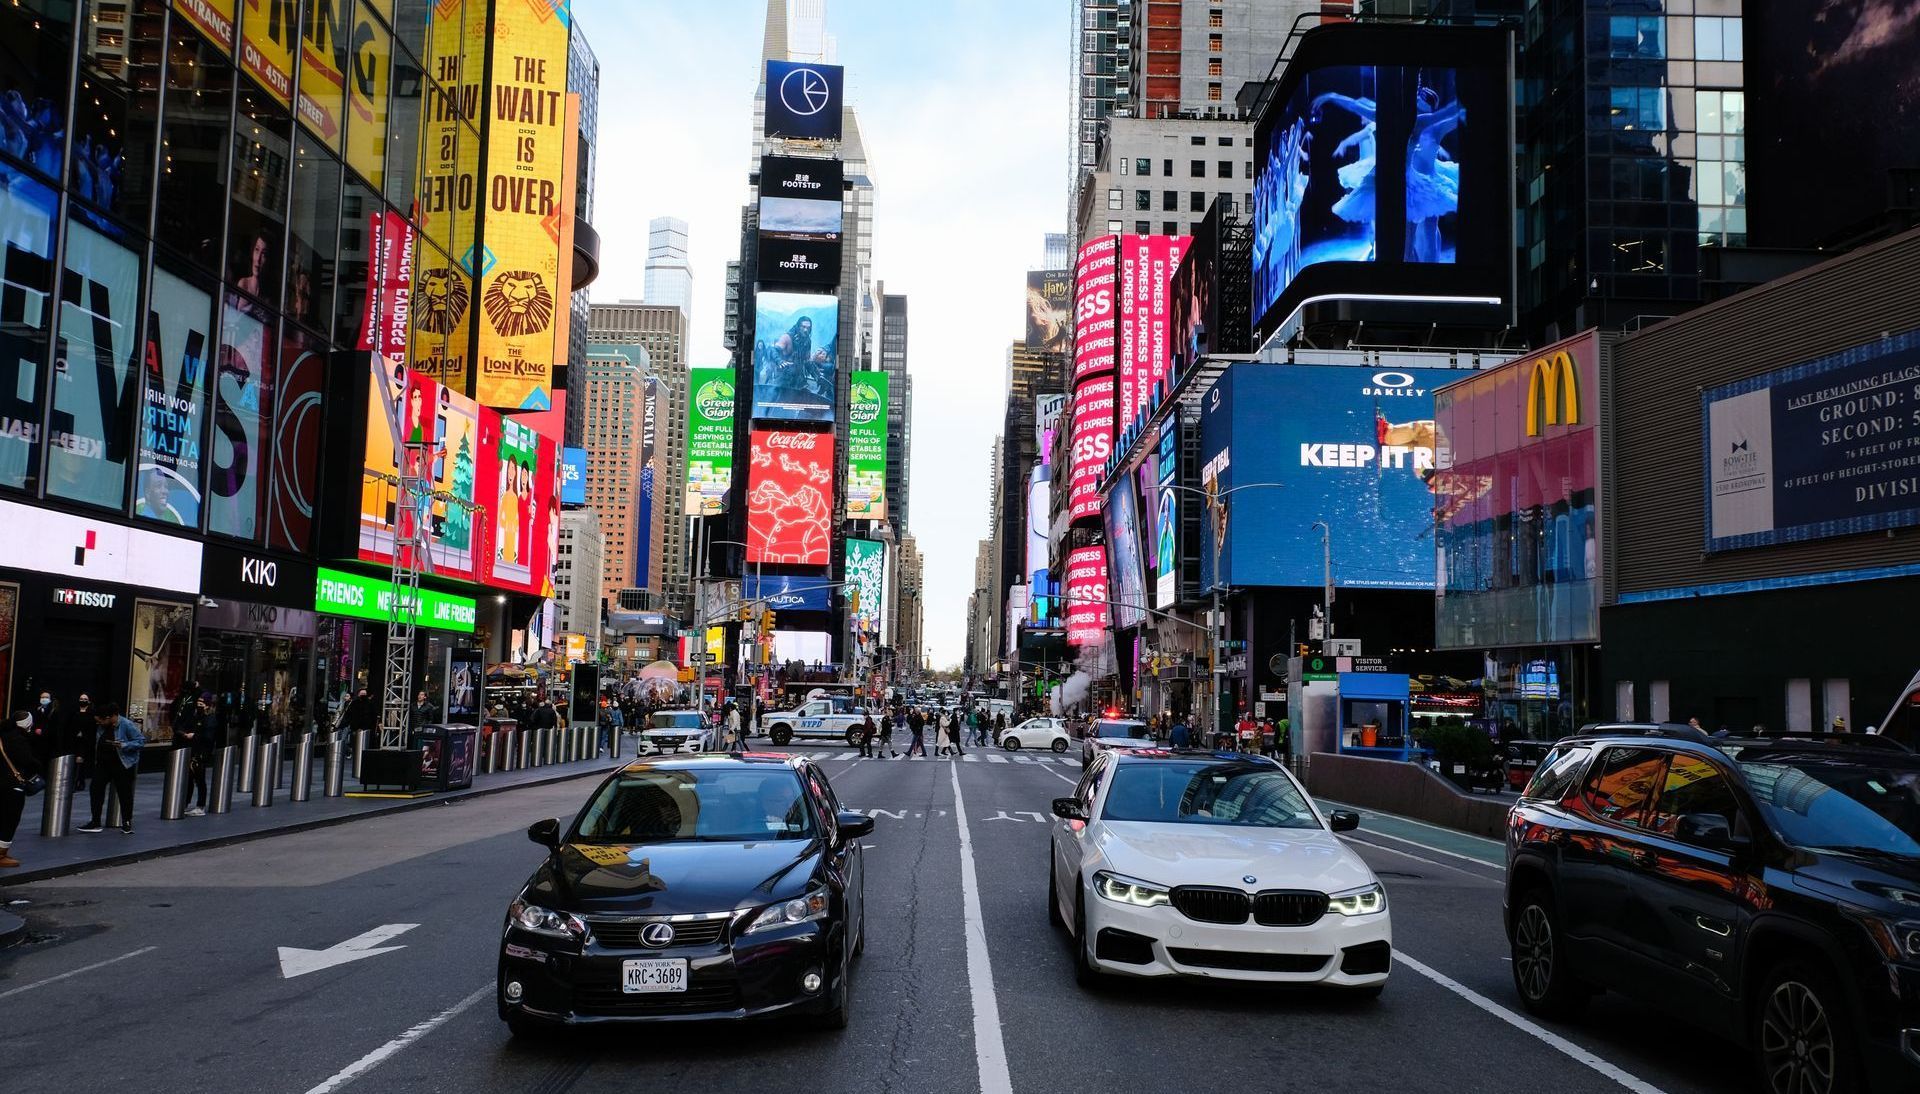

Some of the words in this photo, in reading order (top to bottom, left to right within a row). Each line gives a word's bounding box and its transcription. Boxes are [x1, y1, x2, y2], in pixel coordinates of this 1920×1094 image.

[514, 56, 546, 85] THE
[245, 46, 261, 69] ON
[266, 66, 288, 95] 45TH
[299, 94, 324, 127] STREET
[496, 84, 560, 126] WAIT
[516, 136, 536, 163] IS
[492, 174, 554, 217] OVER
[782, 180, 821, 189] FOOTSTEP
[780, 261, 818, 270] FOOTSTEP
[1138, 246, 1148, 302] EXPRESS
[1124, 260, 1134, 315] EXPRESS
[1154, 260, 1164, 316] EXPRESS
[1122, 320, 1133, 376] EXPRESS
[1138, 307, 1148, 363] EXPRESS
[1152, 320, 1164, 376] EXPRESS
[484, 356, 512, 374] LION
[514, 358, 546, 376] KING
[701, 398, 734, 408] Green
[1362, 388, 1424, 396] OAKLEY
[1788, 394, 1812, 410] LAST
[1816, 376, 1878, 401] REMAINING
[704, 407, 734, 418] Giant
[1820, 390, 1904, 422] GROUND:
[767, 432, 818, 450] Coca-Cola
[1822, 416, 1902, 446] SECOND:
[1300, 444, 1376, 468] KEEP
[1382, 446, 1408, 468] IT
[1859, 443, 1885, 457] FEET
[1889, 440, 1903, 450] OF
[1796, 474, 1819, 486] FEET
[1822, 472, 1836, 482] OF
[242, 556, 277, 587] KIKO
[75, 590, 116, 608] TISSOT
[320, 580, 364, 607] FRIENDS
[248, 604, 278, 623] KIKO
[434, 602, 450, 621] LINE
[628, 968, 648, 984] KRC
[656, 968, 682, 984] 3689
